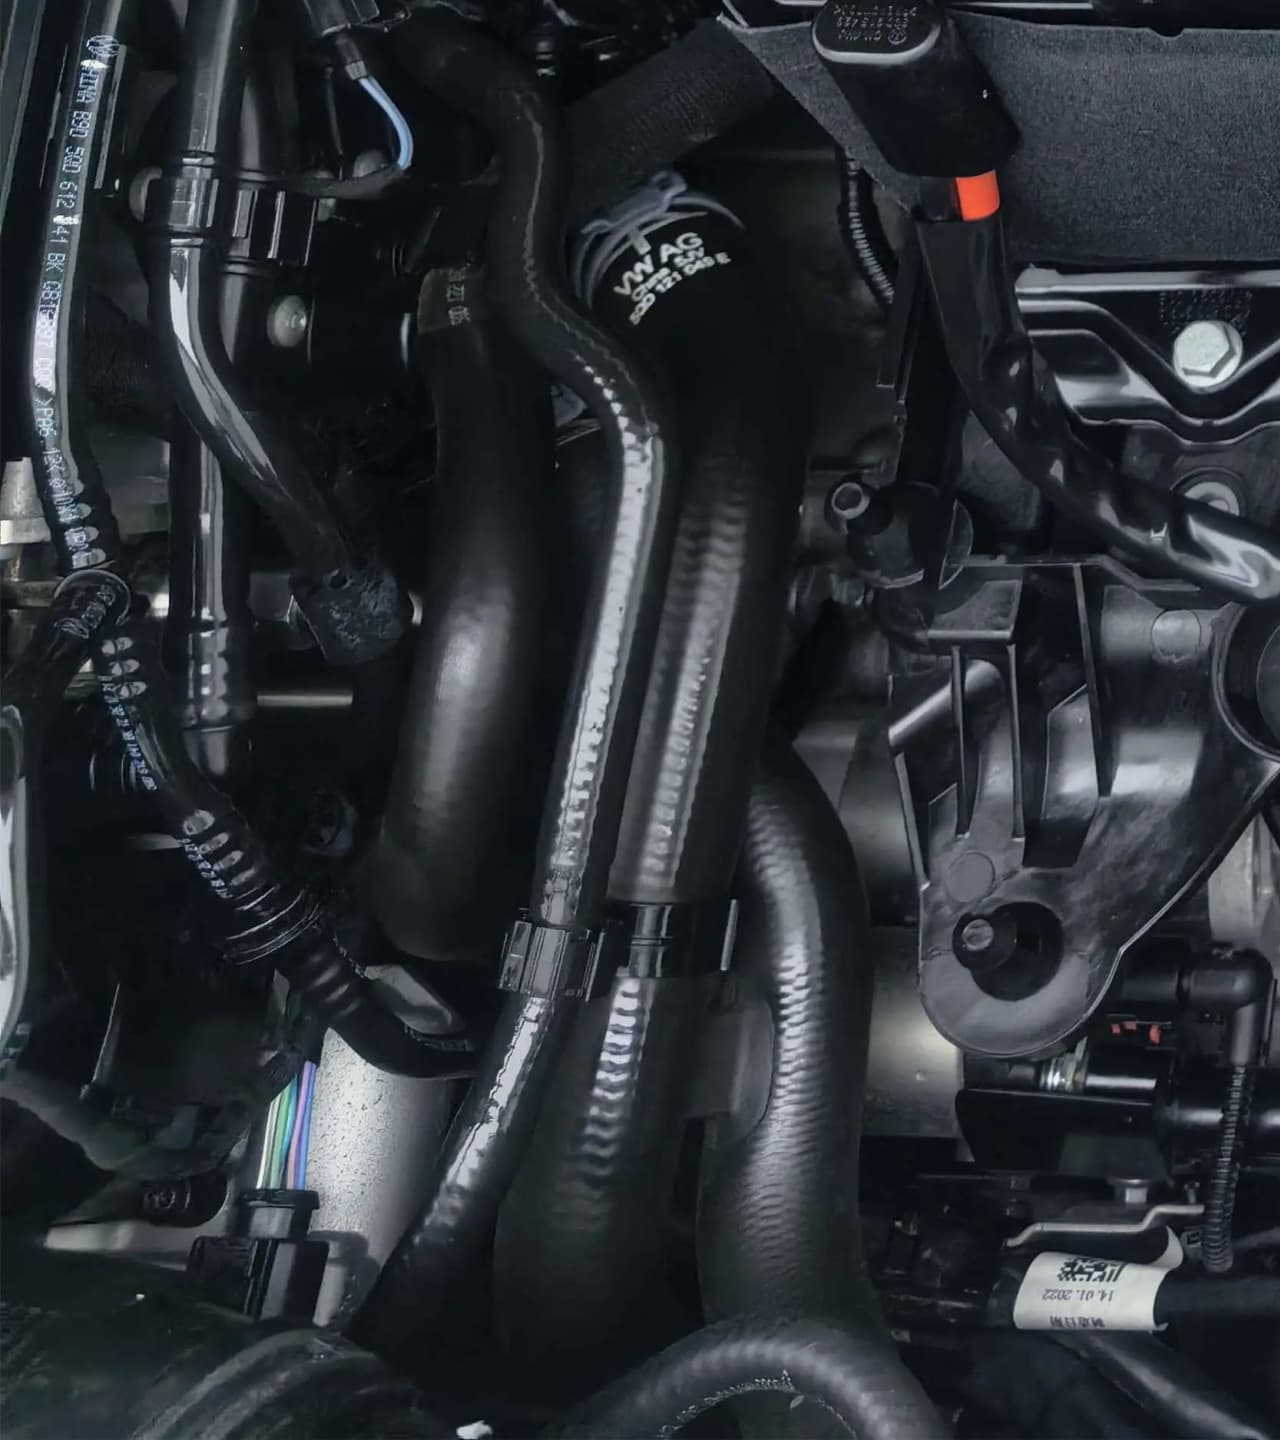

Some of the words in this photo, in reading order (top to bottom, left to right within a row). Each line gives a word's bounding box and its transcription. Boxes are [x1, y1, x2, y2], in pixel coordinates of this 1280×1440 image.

[77, 60, 101, 103] HINA
[56, 181, 78, 209] 612
[46, 252, 66, 272] BK
[614, 254, 655, 295] VW
[660, 232, 704, 264] AG
[630, 266, 672, 301] China
